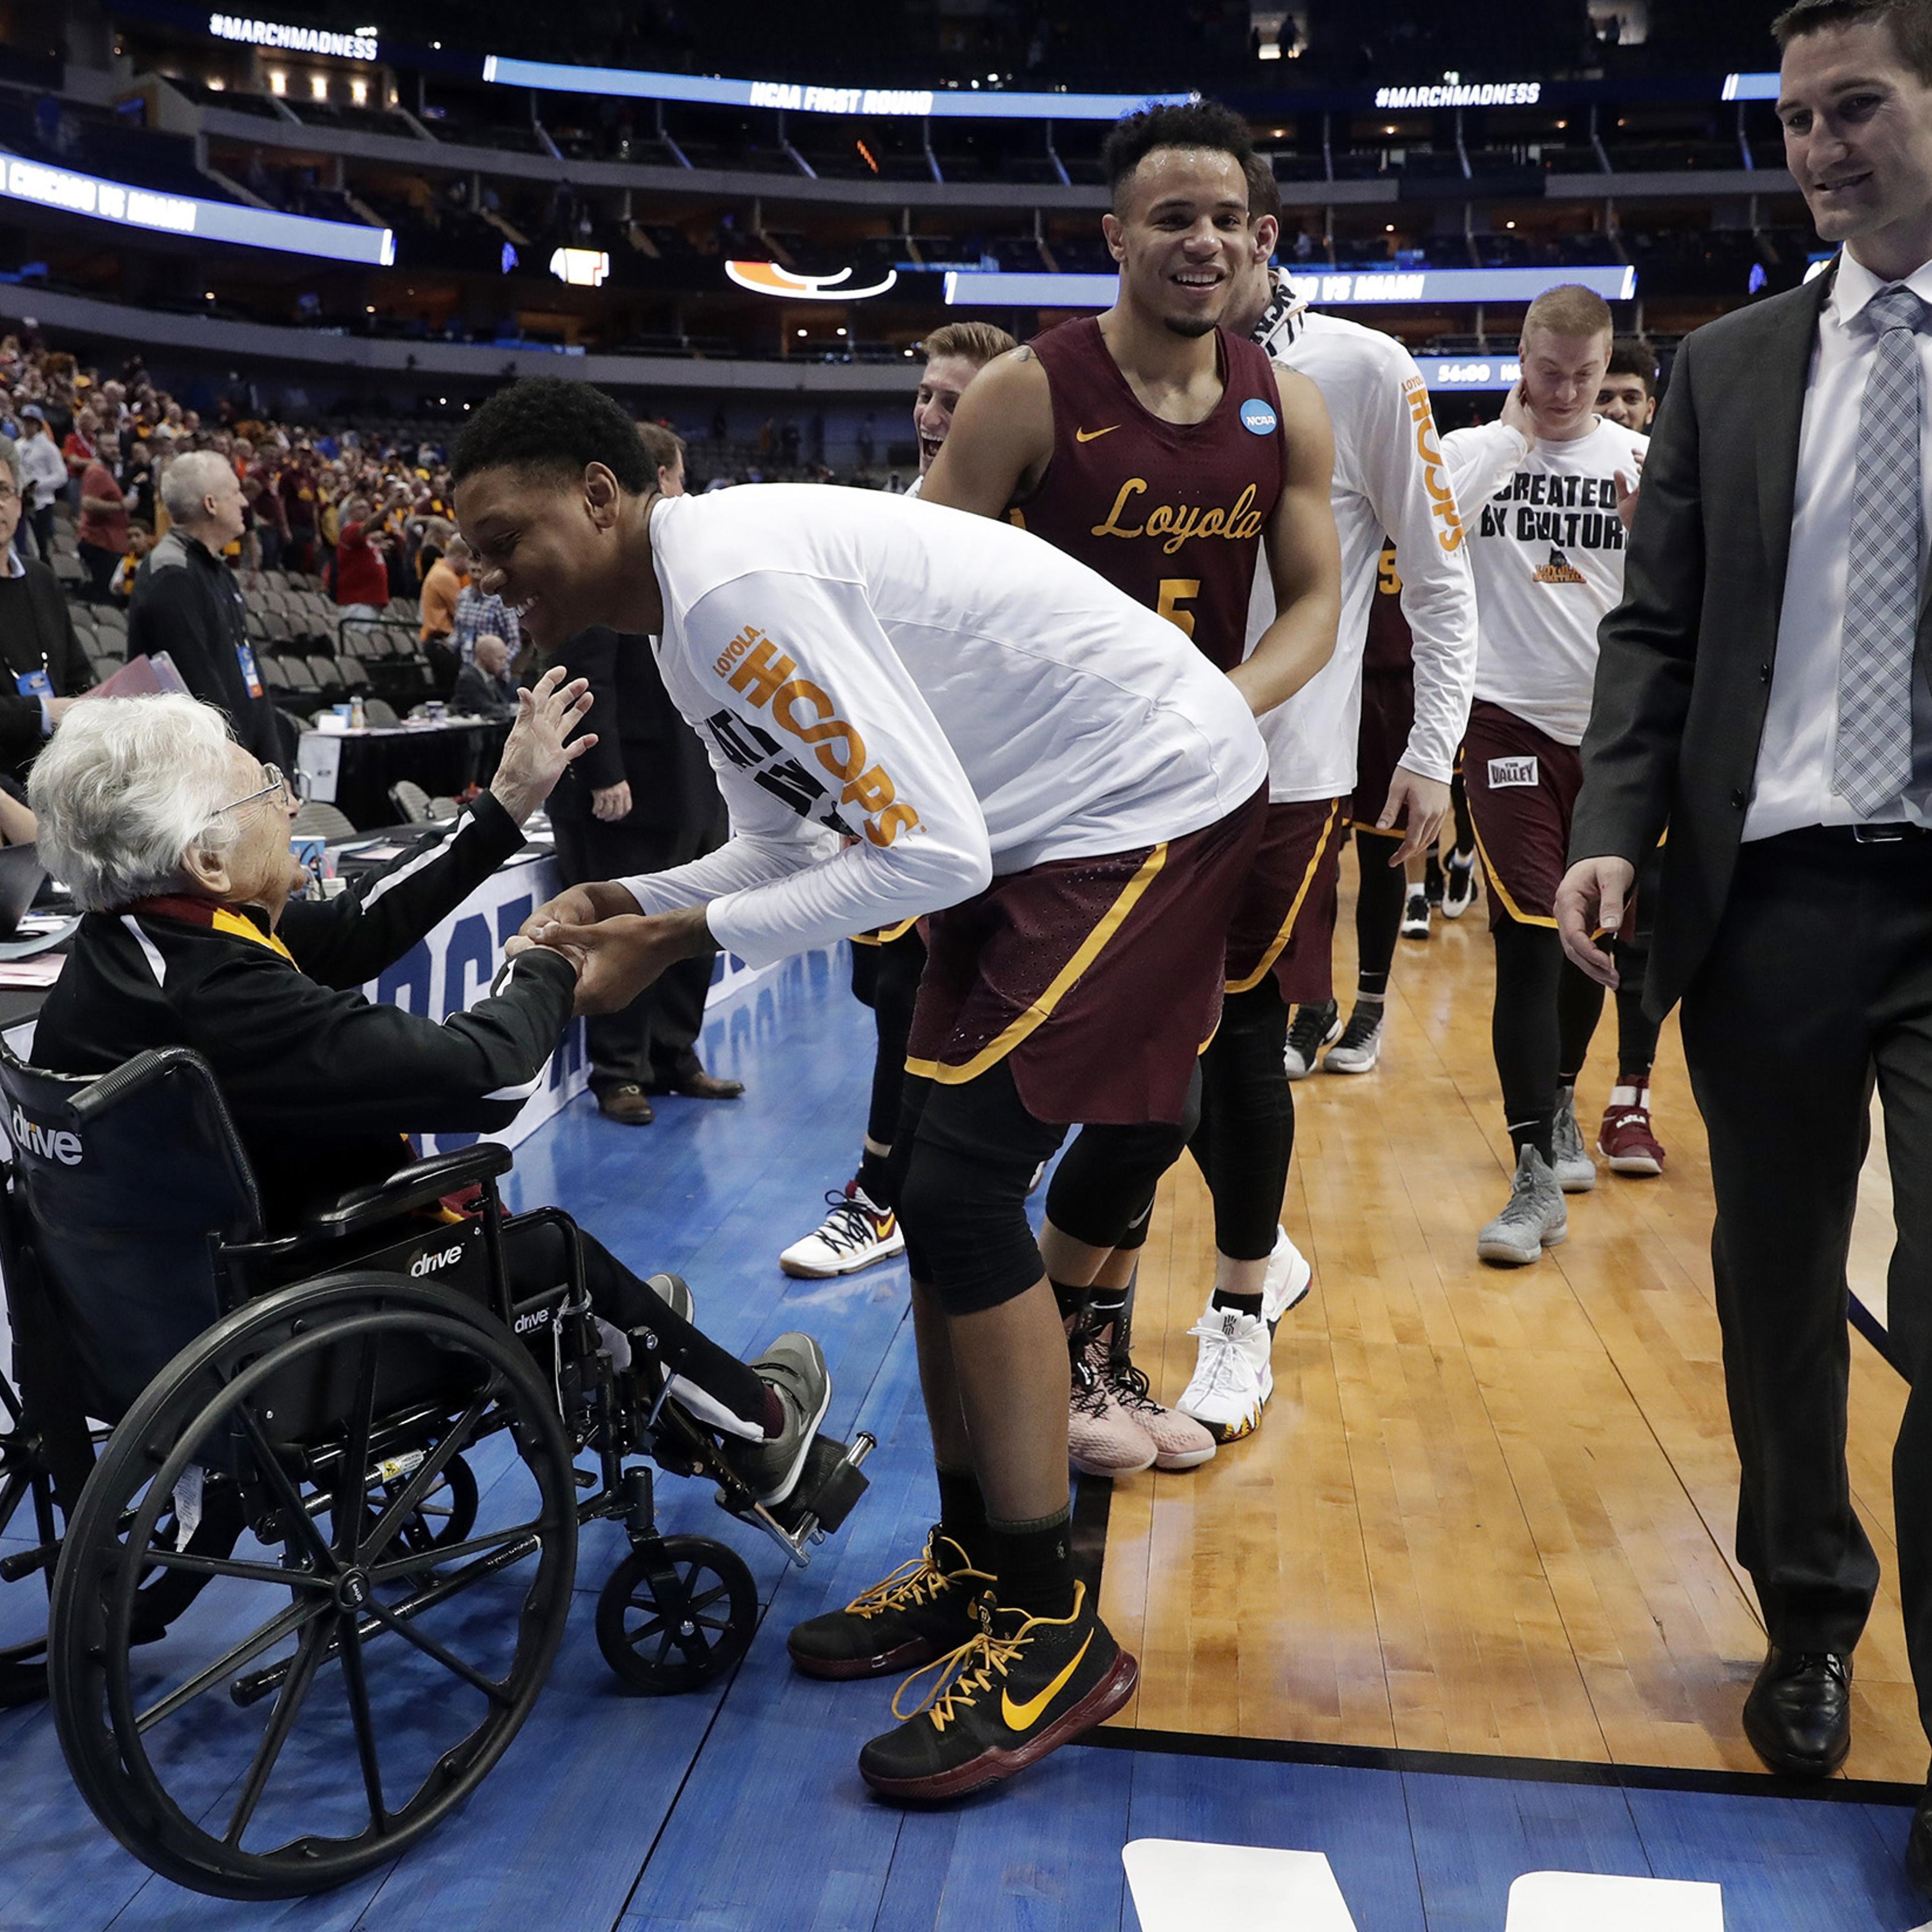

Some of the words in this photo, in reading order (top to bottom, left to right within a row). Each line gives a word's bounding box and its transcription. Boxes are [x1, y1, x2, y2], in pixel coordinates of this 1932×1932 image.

[209, 13, 378, 61] #MARCHMADNESS
[750, 81, 801, 110] NCAA
[803, 86, 862, 114] FIRST
[862, 90, 933, 115] ROUND
[1375, 83, 1541, 108] #MARCHMADNESS
[1322, 276, 1352, 301] VS
[1246, 416, 1275, 426] NCAA
[1090, 477, 1262, 554] Loyola
[1516, 506, 1628, 550] CULTUR
[1157, 579, 1201, 639] 5
[712, 625, 761, 679] LOYOLA
[728, 638, 920, 847] HOOPS
[1490, 761, 1535, 784] VALLEY
[13, 1104, 83, 1165] drive
[411, 1245, 462, 1278] drive
[514, 1309, 548, 1333] drive
